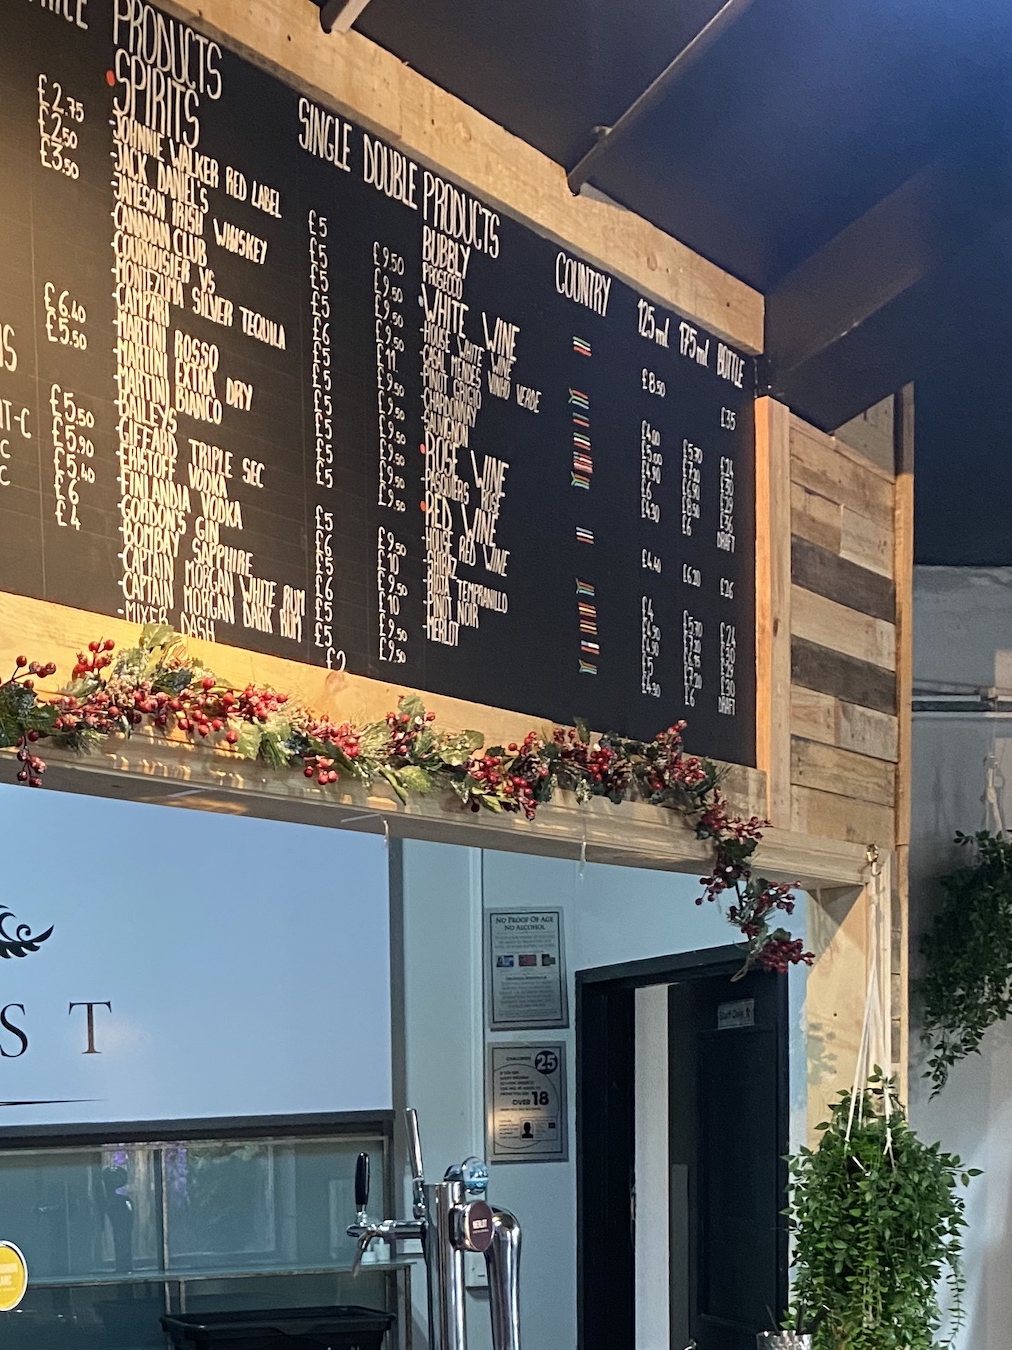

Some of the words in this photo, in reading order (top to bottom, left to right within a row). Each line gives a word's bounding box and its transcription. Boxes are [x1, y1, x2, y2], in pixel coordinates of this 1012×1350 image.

[113, 0, 223, 100] PRODUCTS
[37, 73, 85, 123] £2.75
[113, 48, 200, 149] SPIRITS
[39, 136, 80, 180] £3.50
[112, 109, 165, 163] JOHNNIE
[169, 138, 219, 189] WALKER
[225, 165, 247, 201] RED
[251, 180, 282, 219] LABEL
[113, 139, 148, 184] JACK
[157, 161, 209, 214] DANIEL'S
[298, 97, 353, 173] SINGLE
[363, 133, 418, 211] DOUBLE
[113, 172, 165, 221] JAMESON
[172, 200, 204, 236] IRISH
[213, 218, 268, 265] WHISKEY
[114, 201, 170, 251] CANADIAN
[173, 228, 208, 267] CLUB
[308, 209, 328, 238] £5
[423, 170, 501, 259] PRODUCTS
[114, 230, 191, 283] COURVOISIER
[198, 266, 217, 294] VS
[373, 241, 405, 276] £9.50
[422, 224, 471, 280] BUBBLY
[44, 281, 87, 324] £6.40
[115, 256, 184, 309] MONTEZUMA
[191, 286, 234, 327] SILVER
[239, 305, 286, 350] TEQUILA
[115, 283, 170, 328] CAMPARI
[422, 261, 463, 300] PROSECCO
[555, 251, 612, 317] COUNTRY
[46, 311, 88, 351] £5.50
[117, 309, 167, 353] MARTINI
[174, 329, 220, 373] ROSSO
[312, 316, 330, 346] £6
[421, 283, 470, 339] WHITE
[482, 311, 520, 362] WINE
[637, 298, 670, 348] 125ml
[679, 321, 710, 368] 175ml
[716, 342, 746, 389] BOTTLE
[117, 336, 168, 380] MARTINI
[175, 357, 217, 399] EXTRA
[226, 377, 254, 412] DRY
[423, 320, 451, 353] HOUSE
[457, 335, 485, 368] WHITE
[490, 352, 514, 380] WINE
[49, 383, 95, 428] £5.50
[117, 363, 170, 407] MARTINI
[176, 385, 223, 425] BIANCO
[423, 364, 449, 395] PINOT
[453, 379, 482, 410] GRIGIO
[451, 354, 481, 389] MENDES
[488, 370, 511, 400] VINHO
[516, 383, 542, 413] VERDE
[119, 389, 178, 434] BAILEYS
[424, 409, 469, 448] SAUVIGNON
[720, 406, 736, 431] £35
[51, 417, 95, 458] £5.90
[119, 415, 179, 459] GIFFARD
[188, 438, 234, 479] TRIPLE
[242, 457, 265, 489] SEC
[53, 448, 96, 484] £5.40
[54, 473, 80, 505] £6
[120, 442, 177, 482] ERISTOFF
[188, 462, 228, 499] VODKA
[425, 430, 460, 479] ROSE
[470, 450, 509, 498] WINE
[55, 507, 81, 531] £4
[120, 466, 192, 514] FINLANDIA
[201, 492, 243, 530] VODKA
[121, 494, 187, 535] GORDON'S
[195, 516, 220, 546] GIN
[425, 490, 453, 532] RED
[460, 503, 499, 547] WINE
[481, 489, 501, 516] ROSE
[122, 521, 181, 558] BOMBAY
[192, 538, 254, 578] SAPPHIRE
[425, 526, 454, 558] HOUSE
[458, 535, 477, 566] RED
[482, 543, 511, 577] WINE
[427, 549, 458, 580] SHIRAZ
[122, 545, 175, 583] CAPTAIN
[185, 560, 235, 598] MORGAN
[239, 575, 277, 608] WHITE
[283, 585, 306, 617] RUM
[378, 591, 400, 615] £10
[456, 578, 508, 614] TEMPRANILLO
[122, 571, 175, 610] CAPTAIN
[183, 586, 236, 625] MORGAN
[243, 601, 274, 634] DARK
[280, 610, 302, 643] RUM
[181, 611, 215, 642] DASH
[427, 590, 452, 620] PINOT
[457, 599, 479, 629] NOIR
[427, 614, 460, 647] MERLOT
[315, 621, 333, 648] £5
[379, 636, 406, 664] £9.50
[537, 1055, 556, 1070] 25
[532, 1091, 549, 1106] 18
